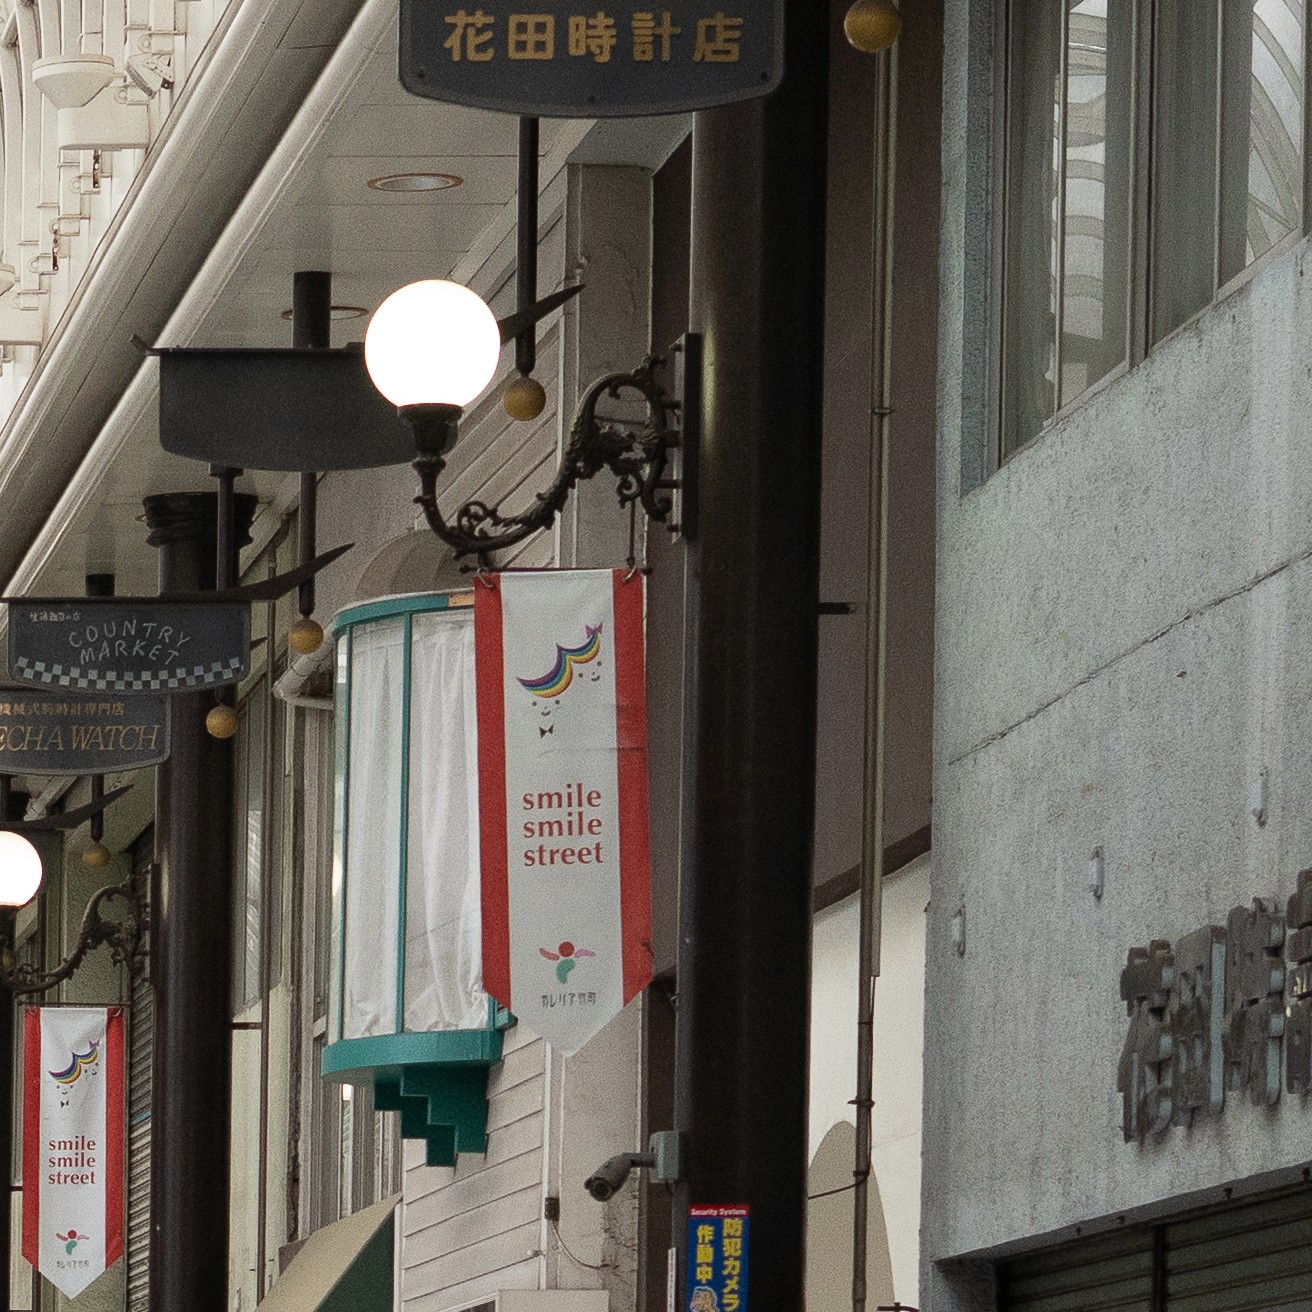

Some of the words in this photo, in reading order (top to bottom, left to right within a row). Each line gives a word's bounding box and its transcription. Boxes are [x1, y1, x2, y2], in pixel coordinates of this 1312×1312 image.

[442, 8, 745, 64] 花田時計店
[68, 619, 191, 648] COUNTRY
[80, 639, 180, 666] MARKET
[70, 724, 161, 751] WATCH
[522, 782, 605, 811] smile
[522, 810, 605, 839] smile
[522, 841, 605, 867] street
[48, 1135, 97, 1151] smile
[48, 1152, 97, 1168] smile
[48, 1170, 97, 1185] street
[719, 1208, 747, 1217] System
[696, 1224, 714, 1285] 作動中
[722, 1217, 744, 1312] 防犯カメラ
